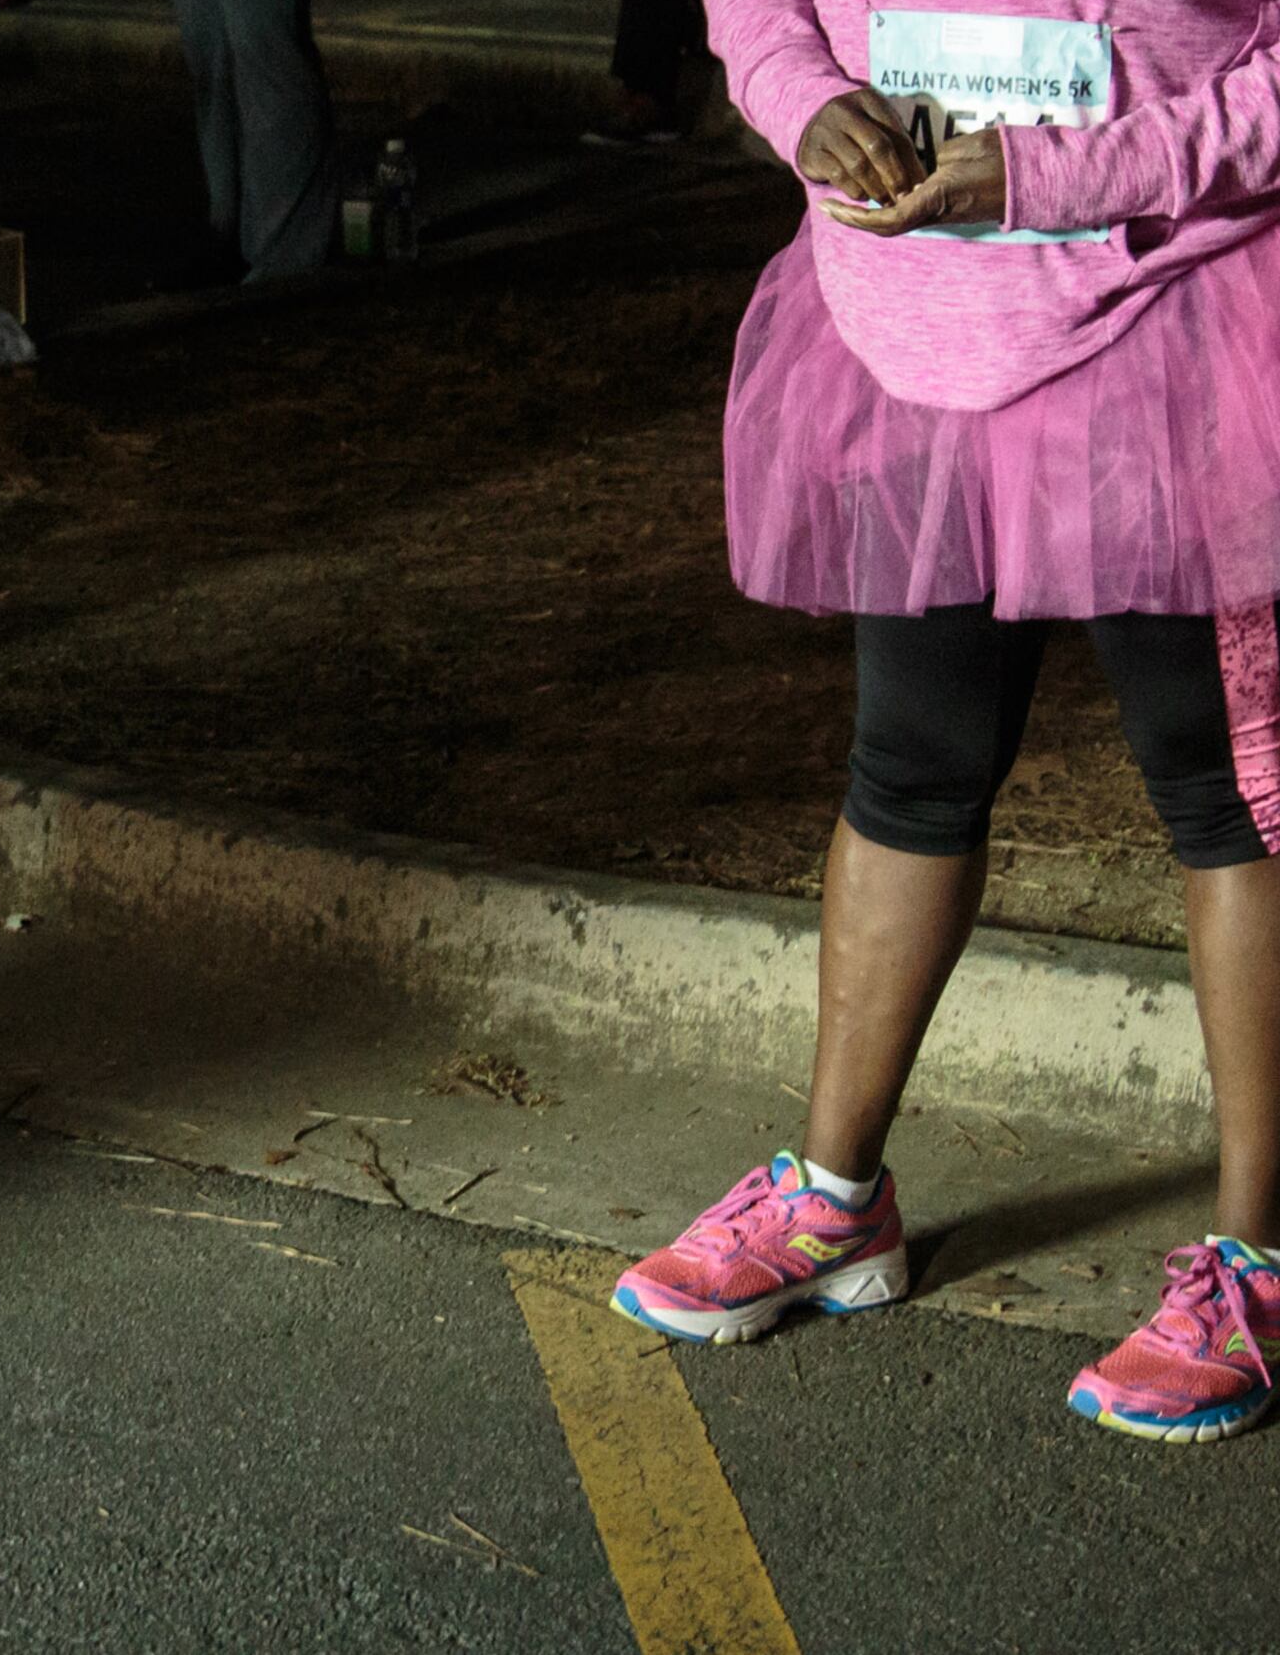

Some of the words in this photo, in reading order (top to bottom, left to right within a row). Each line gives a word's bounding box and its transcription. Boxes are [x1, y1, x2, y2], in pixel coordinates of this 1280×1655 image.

[880, 69, 960, 91] ATLANTA
[966, 75, 1062, 95] WOMEN'S
[1068, 80, 1093, 98] 5K
